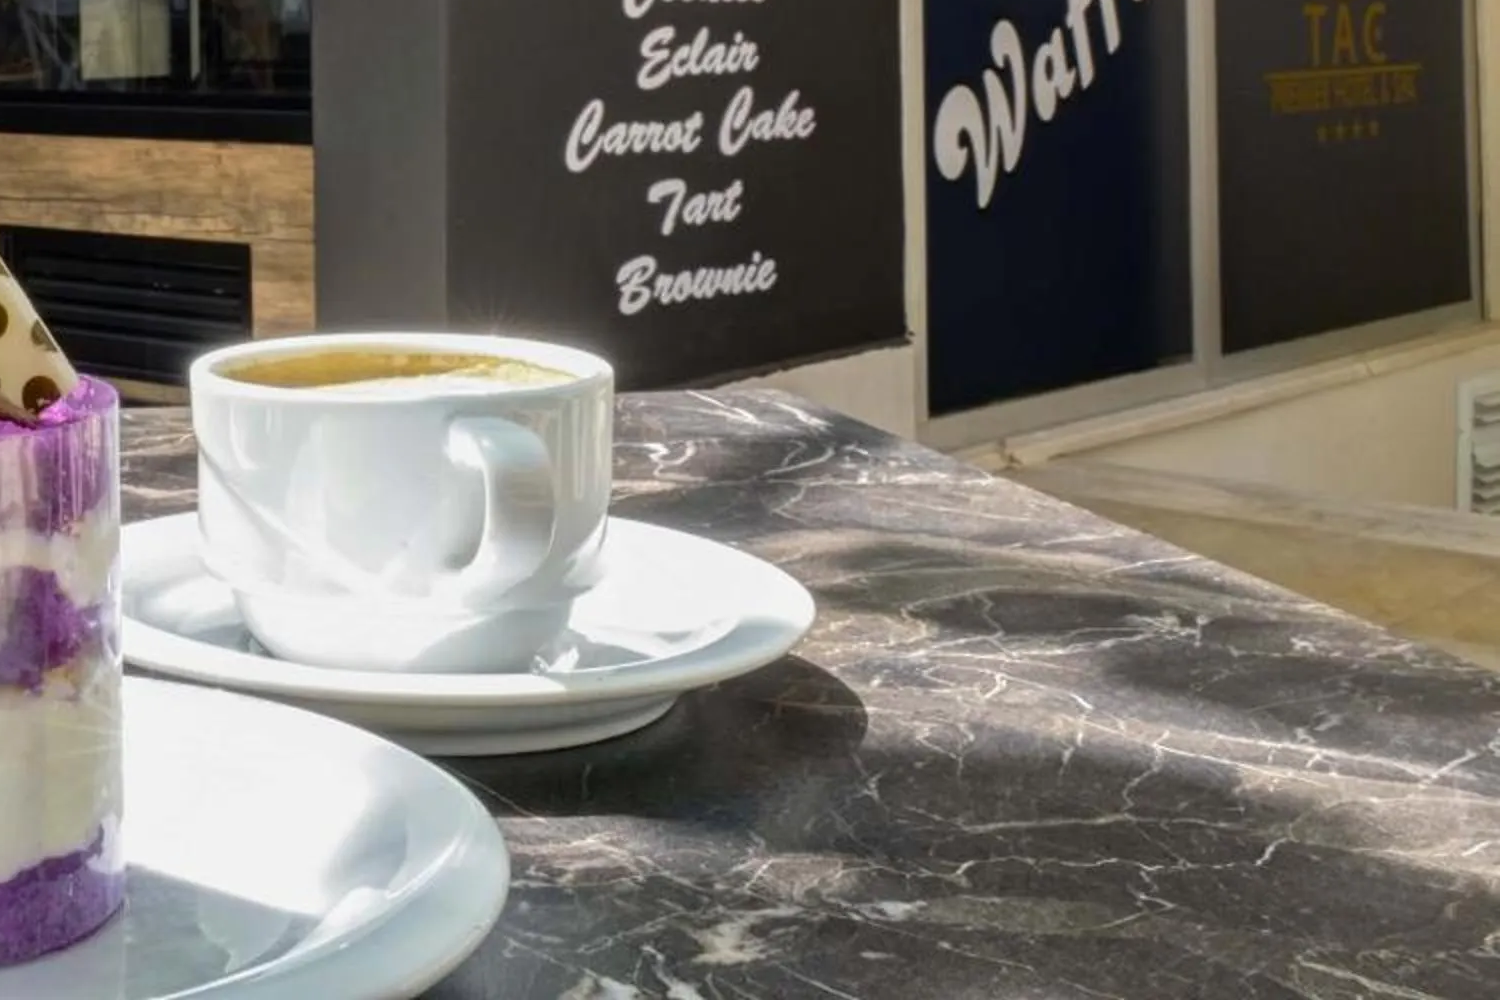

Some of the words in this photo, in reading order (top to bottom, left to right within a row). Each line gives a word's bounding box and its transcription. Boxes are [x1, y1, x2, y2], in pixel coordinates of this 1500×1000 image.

[636, 25, 760, 91] Eclair
[1303, 1, 1388, 67] TAC
[564, 98, 706, 174] Carrot
[718, 85, 818, 157] Cake
[647, 177, 745, 237] Tart
[615, 250, 780, 317] Brownie
